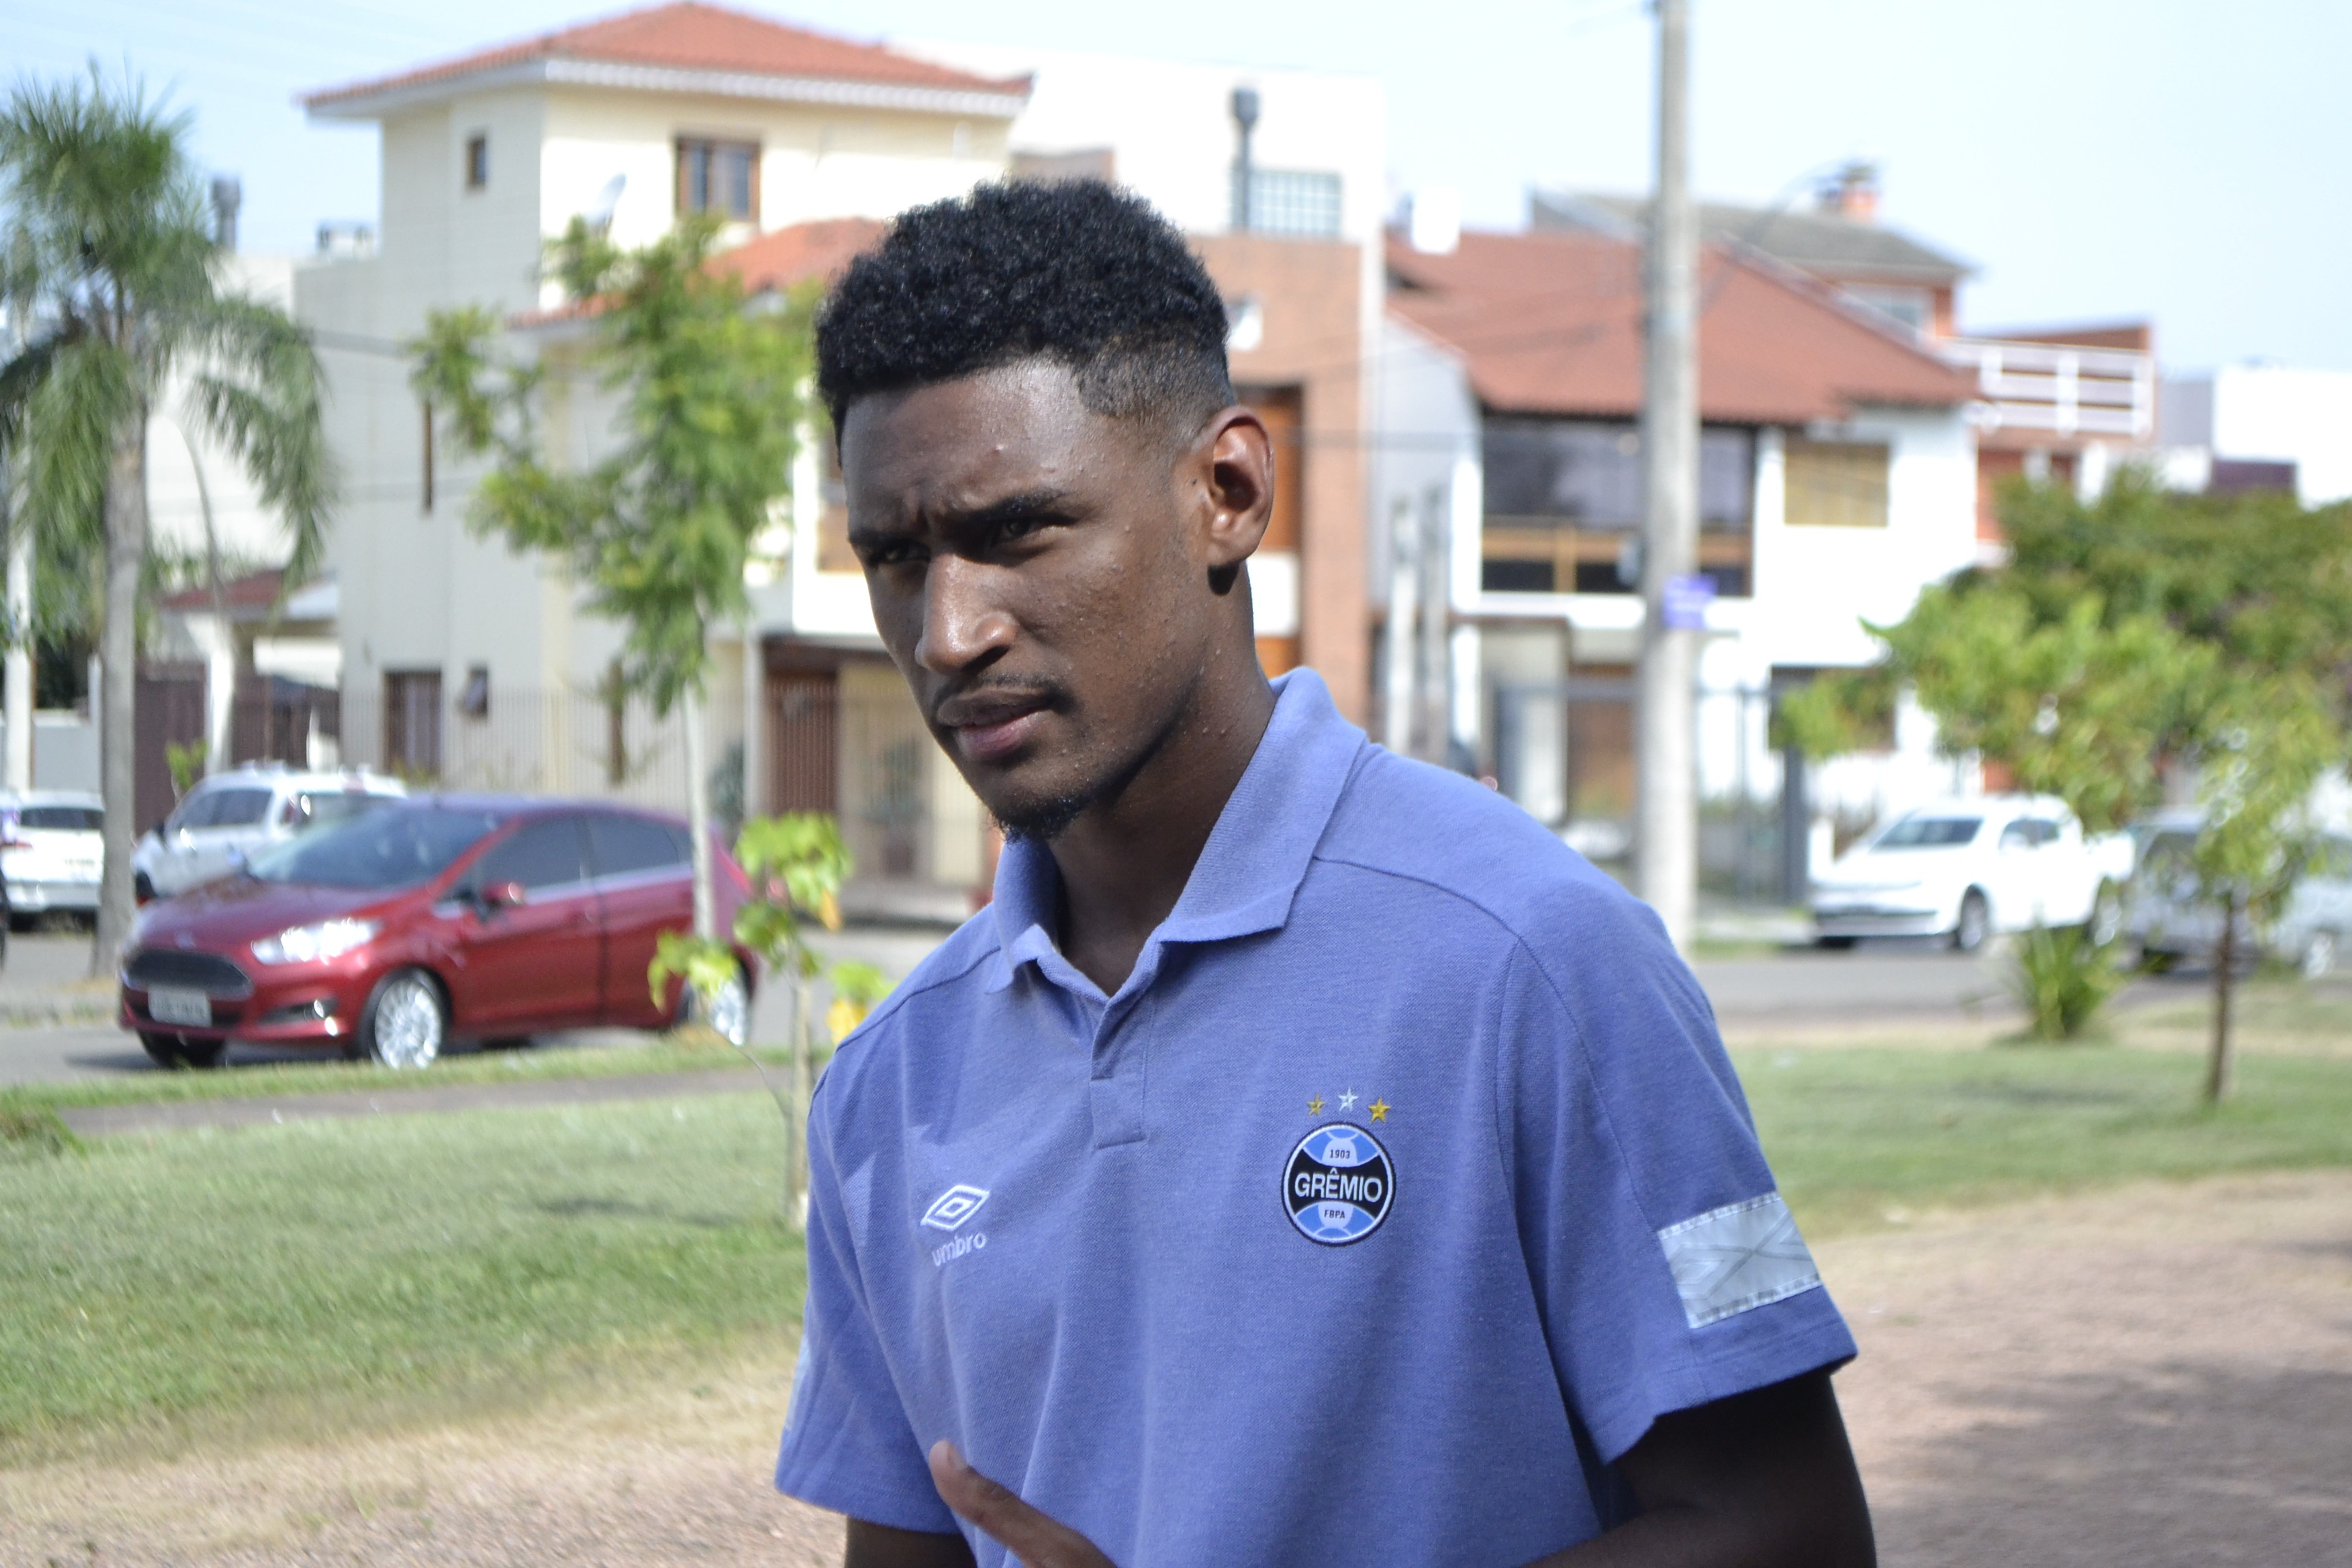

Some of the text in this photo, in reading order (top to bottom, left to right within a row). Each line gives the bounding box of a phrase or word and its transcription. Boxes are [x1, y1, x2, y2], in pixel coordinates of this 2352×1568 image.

[1329, 1149, 1350, 1160] 1903
[1294, 1167, 1382, 1203] GRÊMIO
[1324, 1209, 1345, 1220] FBPA
[932, 1232, 987, 1266] umbro
